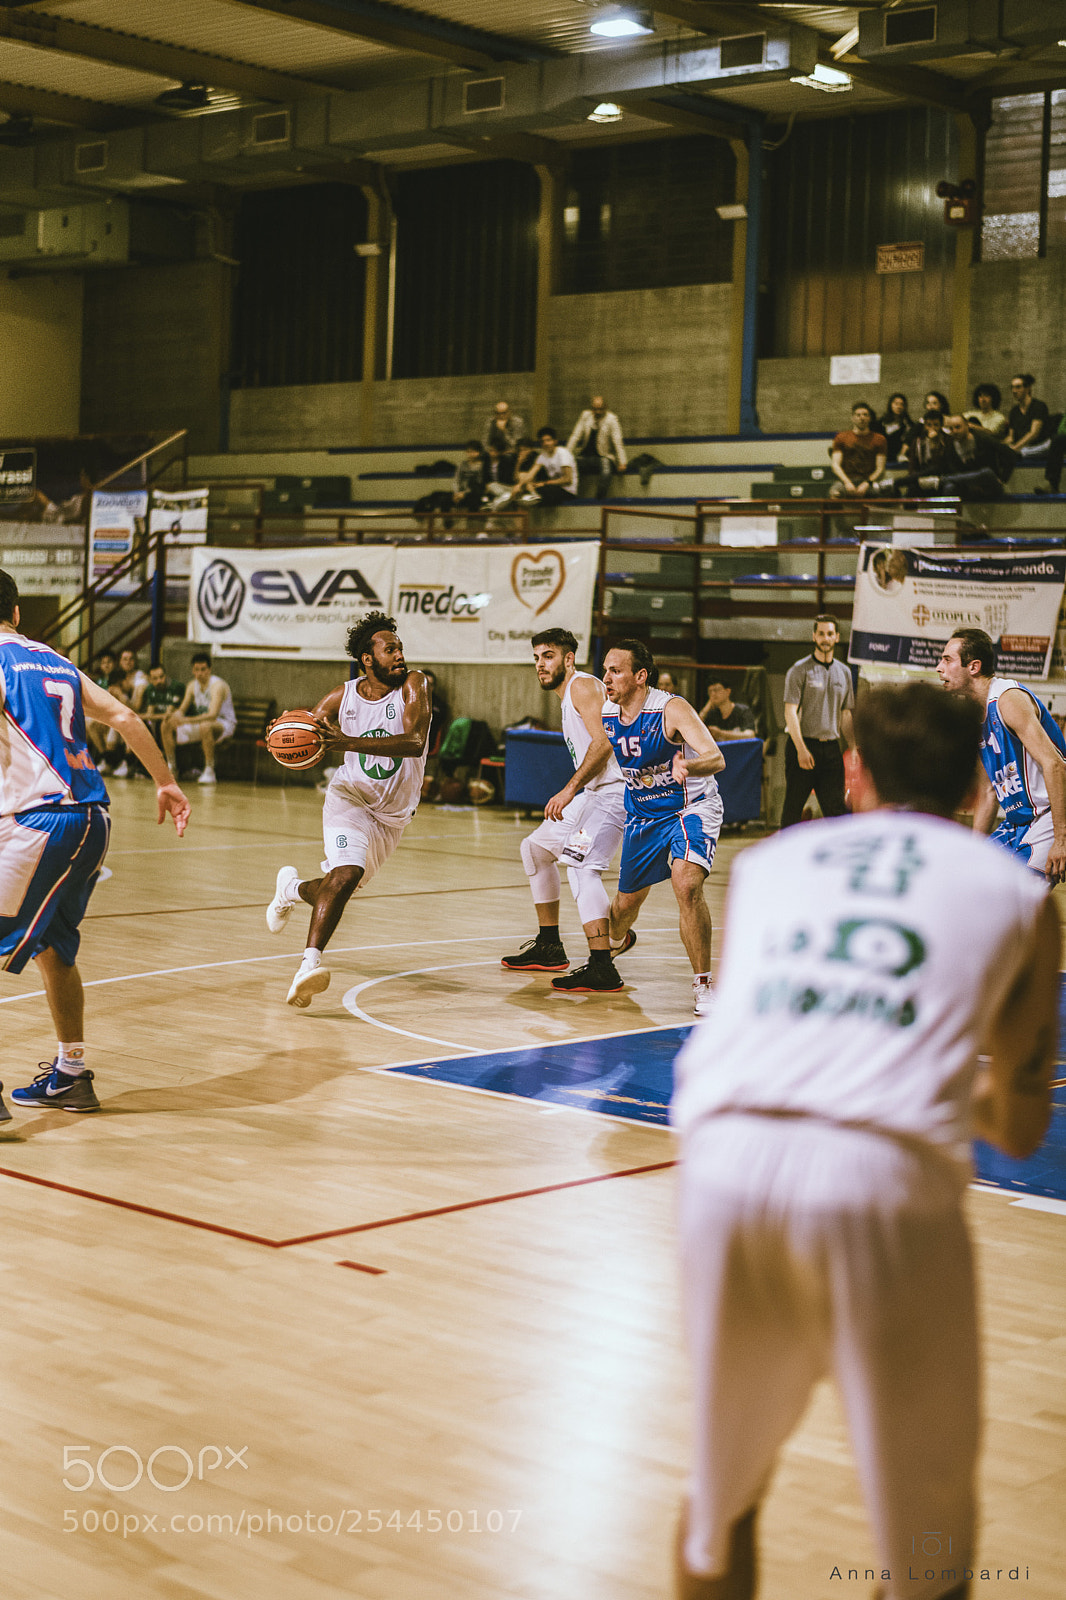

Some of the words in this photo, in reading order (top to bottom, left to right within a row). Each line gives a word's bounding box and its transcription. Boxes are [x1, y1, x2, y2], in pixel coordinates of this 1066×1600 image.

[250, 568, 382, 607] SVA
[931, 610, 982, 624] OTOPLUS
[42, 677, 76, 743] 7
[386, 703, 396, 720] 6
[616, 735, 642, 758] 15
[335, 834, 349, 849] 6
